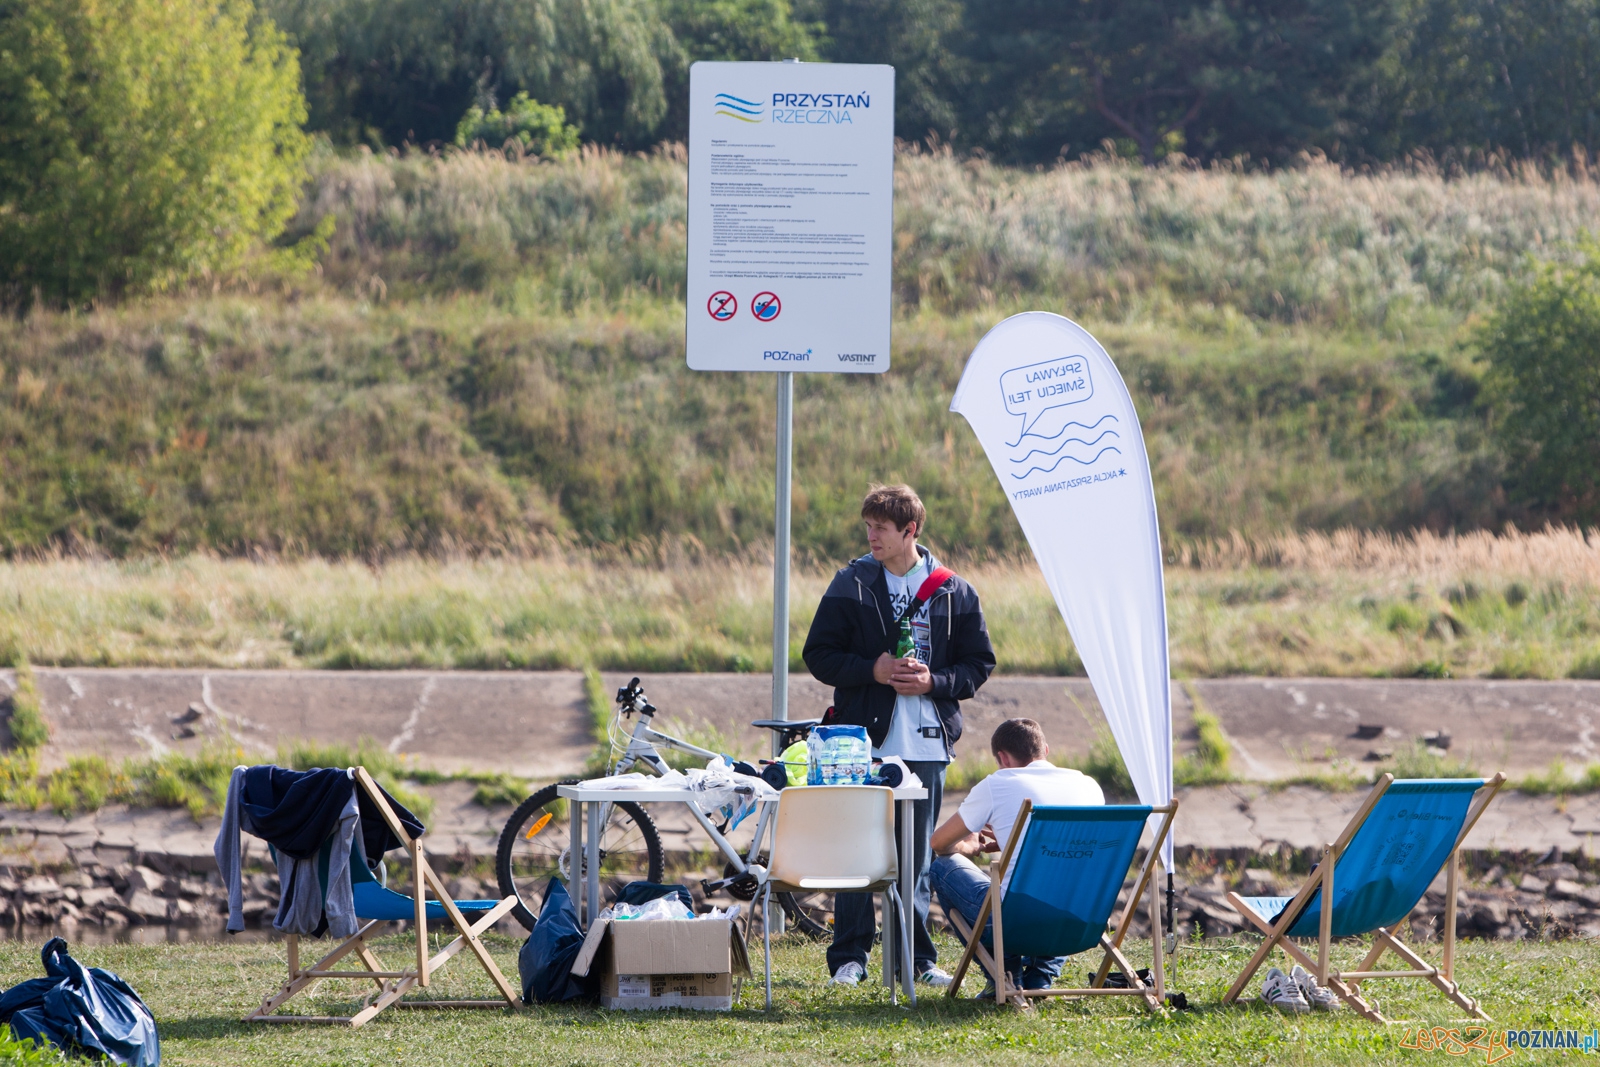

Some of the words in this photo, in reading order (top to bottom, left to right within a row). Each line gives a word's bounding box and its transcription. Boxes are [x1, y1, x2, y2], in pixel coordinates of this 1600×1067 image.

[772, 91, 870, 108] PRZYSTAŃ
[772, 109, 853, 124] RZECZNA
[837, 354, 877, 362] VASTINT
